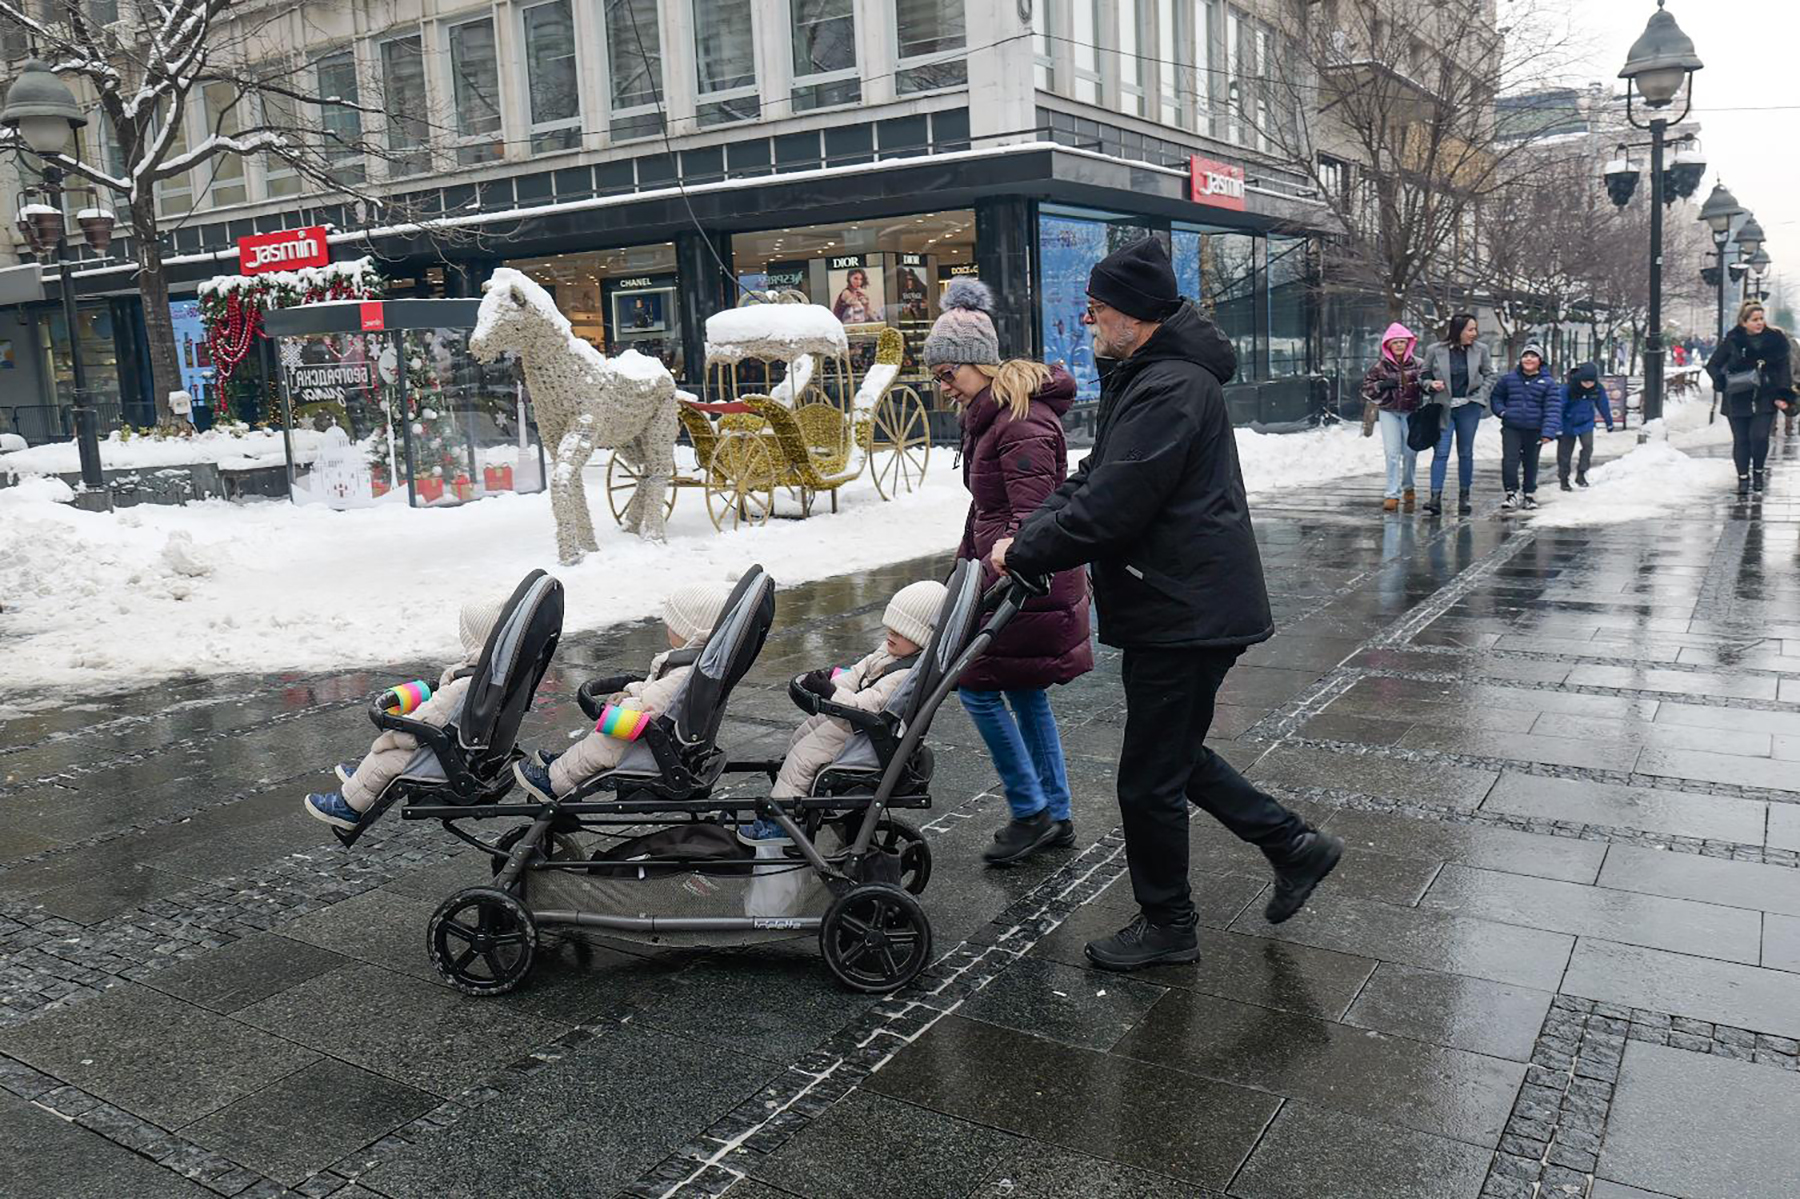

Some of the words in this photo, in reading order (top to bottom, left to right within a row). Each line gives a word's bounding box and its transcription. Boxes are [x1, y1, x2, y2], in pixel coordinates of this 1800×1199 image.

[1199, 168, 1245, 198] Jasmin
[245, 230, 318, 268] Jasmin
[833, 256, 859, 268] DIOR
[902, 255, 920, 265] DIOR
[620, 277, 652, 288] CHANEL
